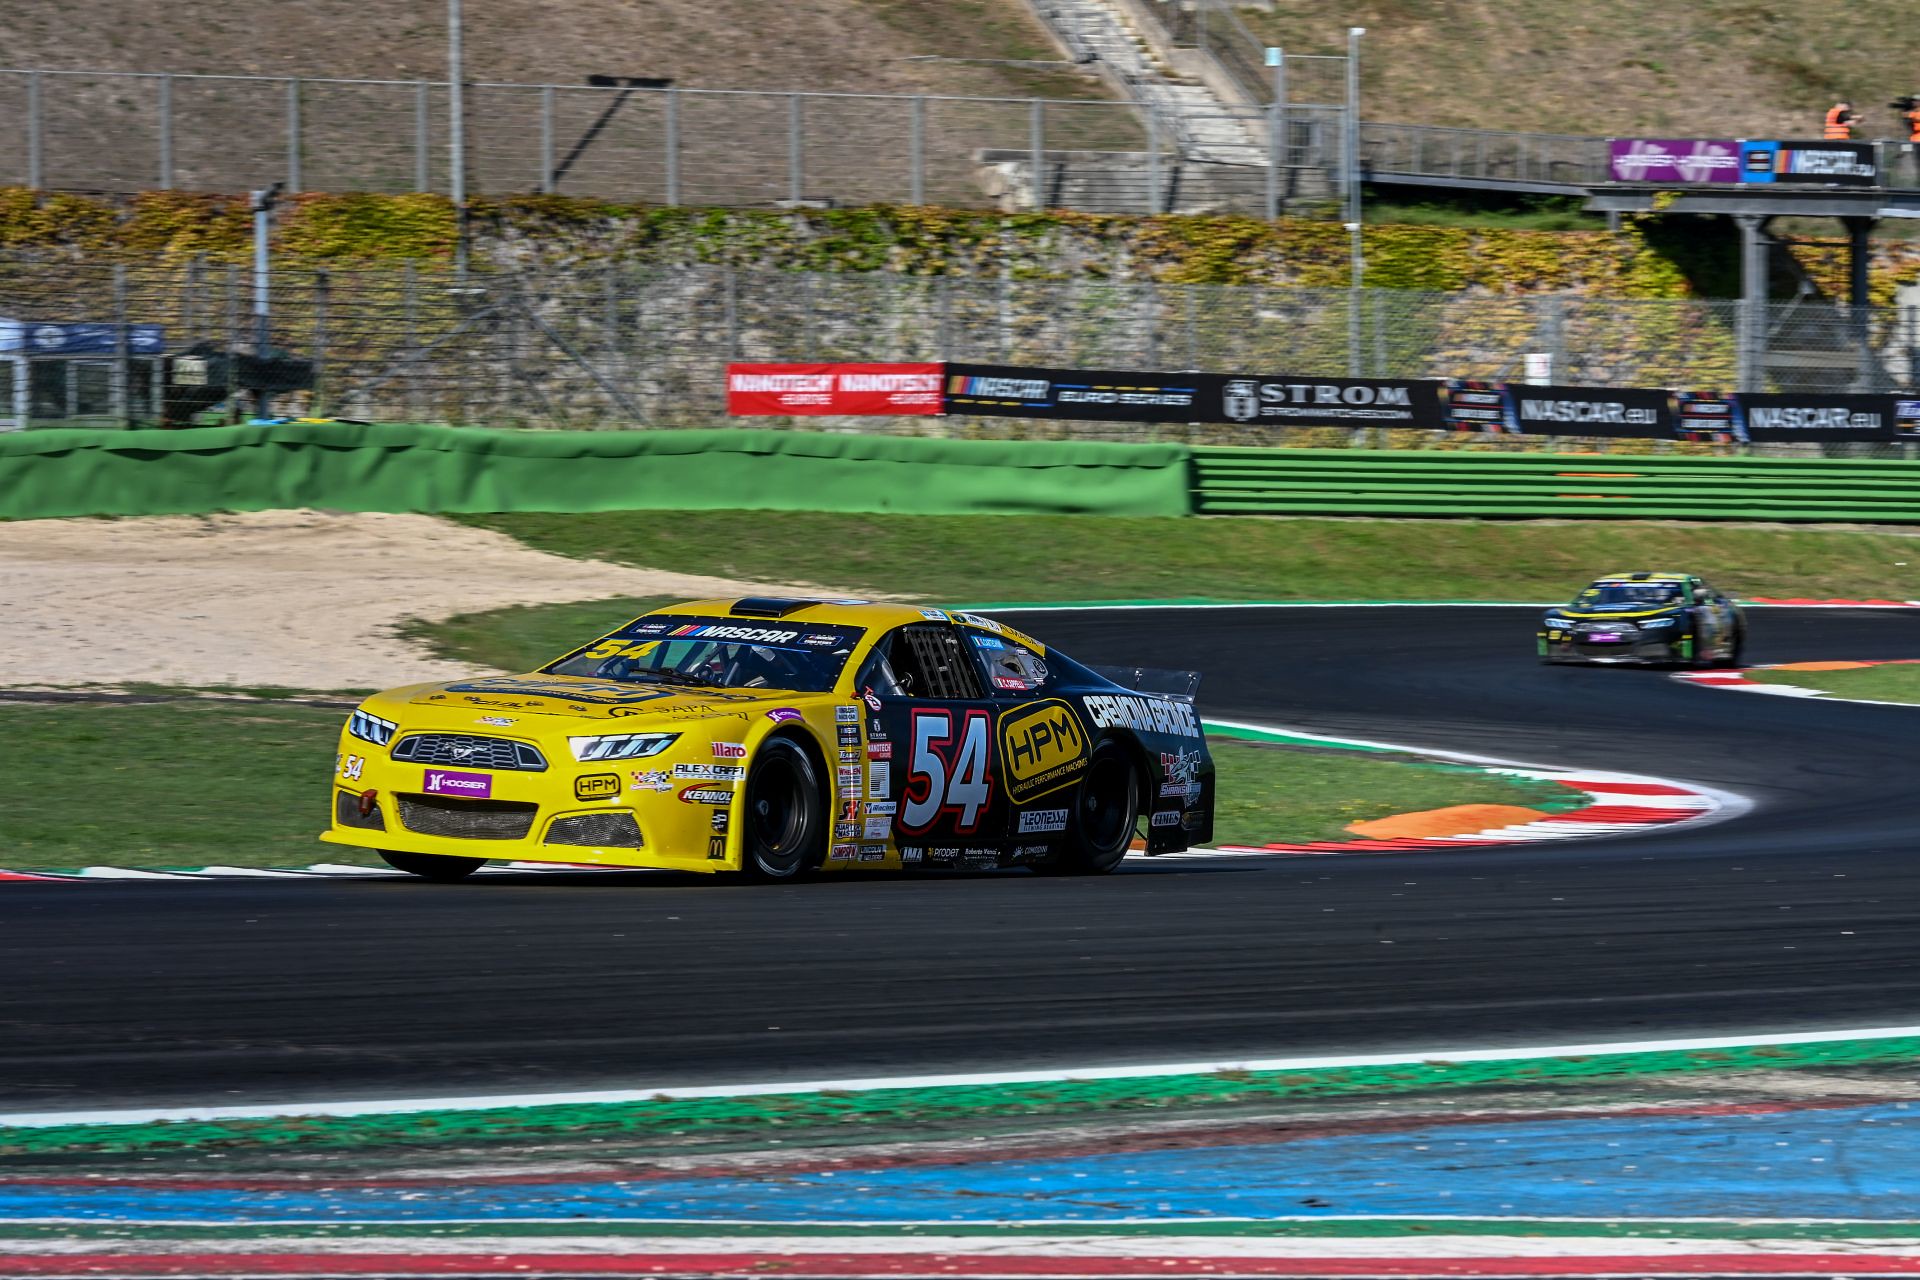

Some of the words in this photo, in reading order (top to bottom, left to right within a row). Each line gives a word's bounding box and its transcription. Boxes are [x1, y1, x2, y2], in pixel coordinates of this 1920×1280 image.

[1260, 384, 1412, 405] STROM
[697, 626, 798, 643] NASCAR
[585, 640, 662, 659] 54
[868, 744, 891, 752] NANOTECH
[1010, 713, 1077, 771] HPM
[342, 755, 364, 780] 54
[675, 765, 709, 774] ALEX
[900, 712, 991, 830] 54
[1034, 766, 1066, 785] PERFORMANCE
[441, 779, 487, 790] HOOSIER
[580, 780, 616, 793] HPM
[683, 791, 732, 801] KENNOL
